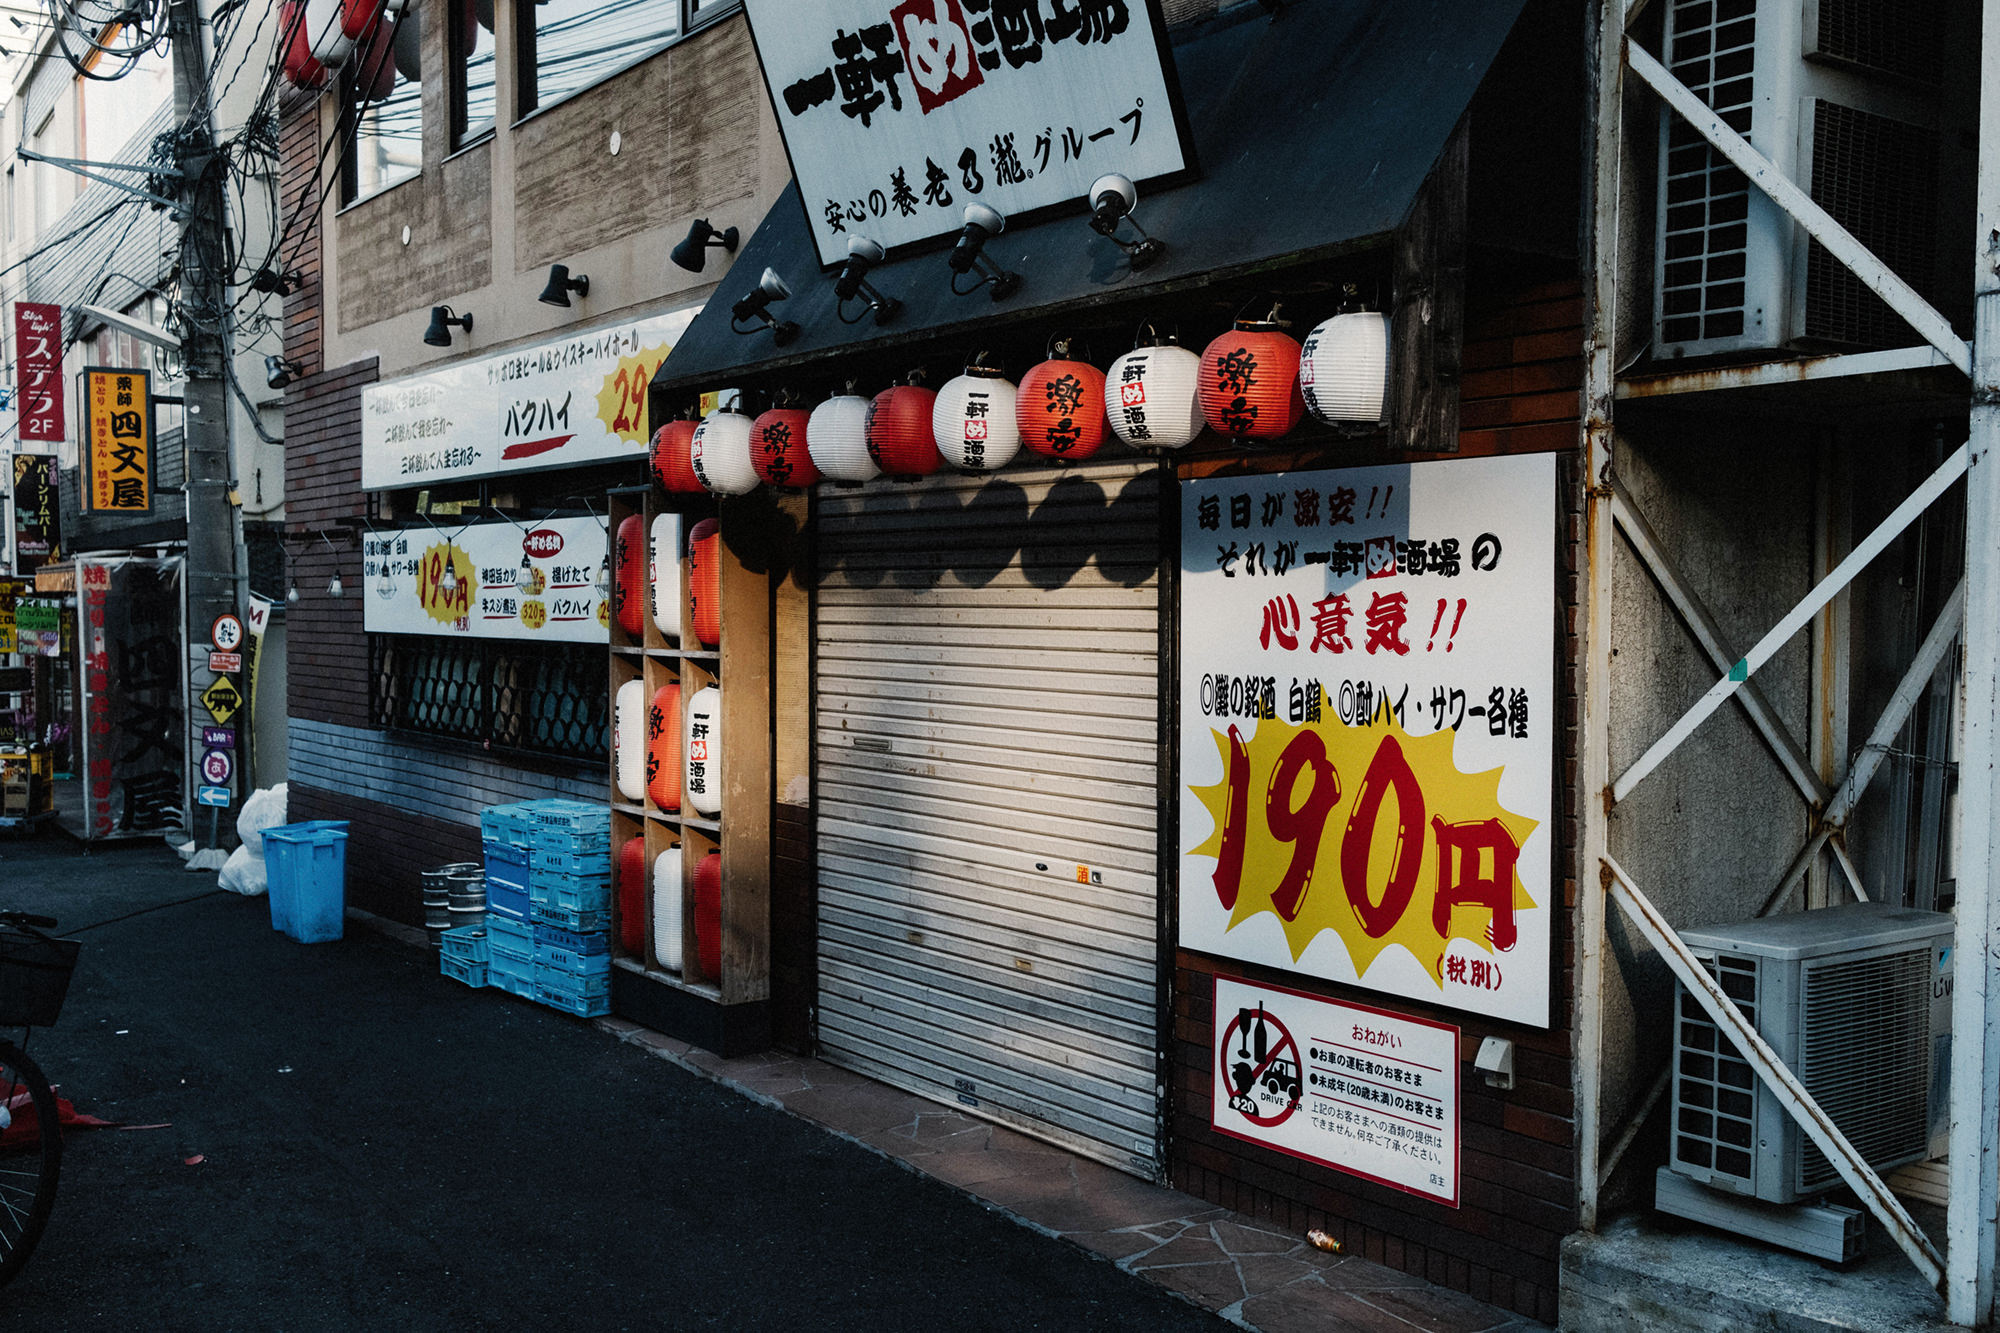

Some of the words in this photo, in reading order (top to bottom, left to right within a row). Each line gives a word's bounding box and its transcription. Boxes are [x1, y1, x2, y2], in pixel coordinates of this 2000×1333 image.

[25, 336, 53, 414] ステラ
[116, 376, 132, 407] 薬師
[613, 359, 662, 433] 29
[1120, 354, 1152, 442] 一軒め酒場
[1216, 347, 1258, 433] 激安
[29, 418, 53, 433] 2F
[963, 391, 990, 469] 一軒め酒場
[1046, 373, 1083, 454] 激安
[110, 410, 145, 508] 四文屋
[762, 421, 794, 484] 激安
[1216, 532, 1501, 580] それが一軒め酒場の
[1259, 591, 1467, 656] 心意気!!
[212, 732, 227, 744] BAR
[689, 713, 711, 794] 一軒め酒場
[1211, 723, 1521, 953] 190円
[1352, 1024, 1402, 1048] おねがい
[1261, 1092, 1285, 1107] DRIVE
[1287, 1100, 1303, 1112] CAR
[1311, 1101, 1442, 1149] 上記のお客さまへの酒類の提供は
[1429, 1173, 1445, 1188] 店主
